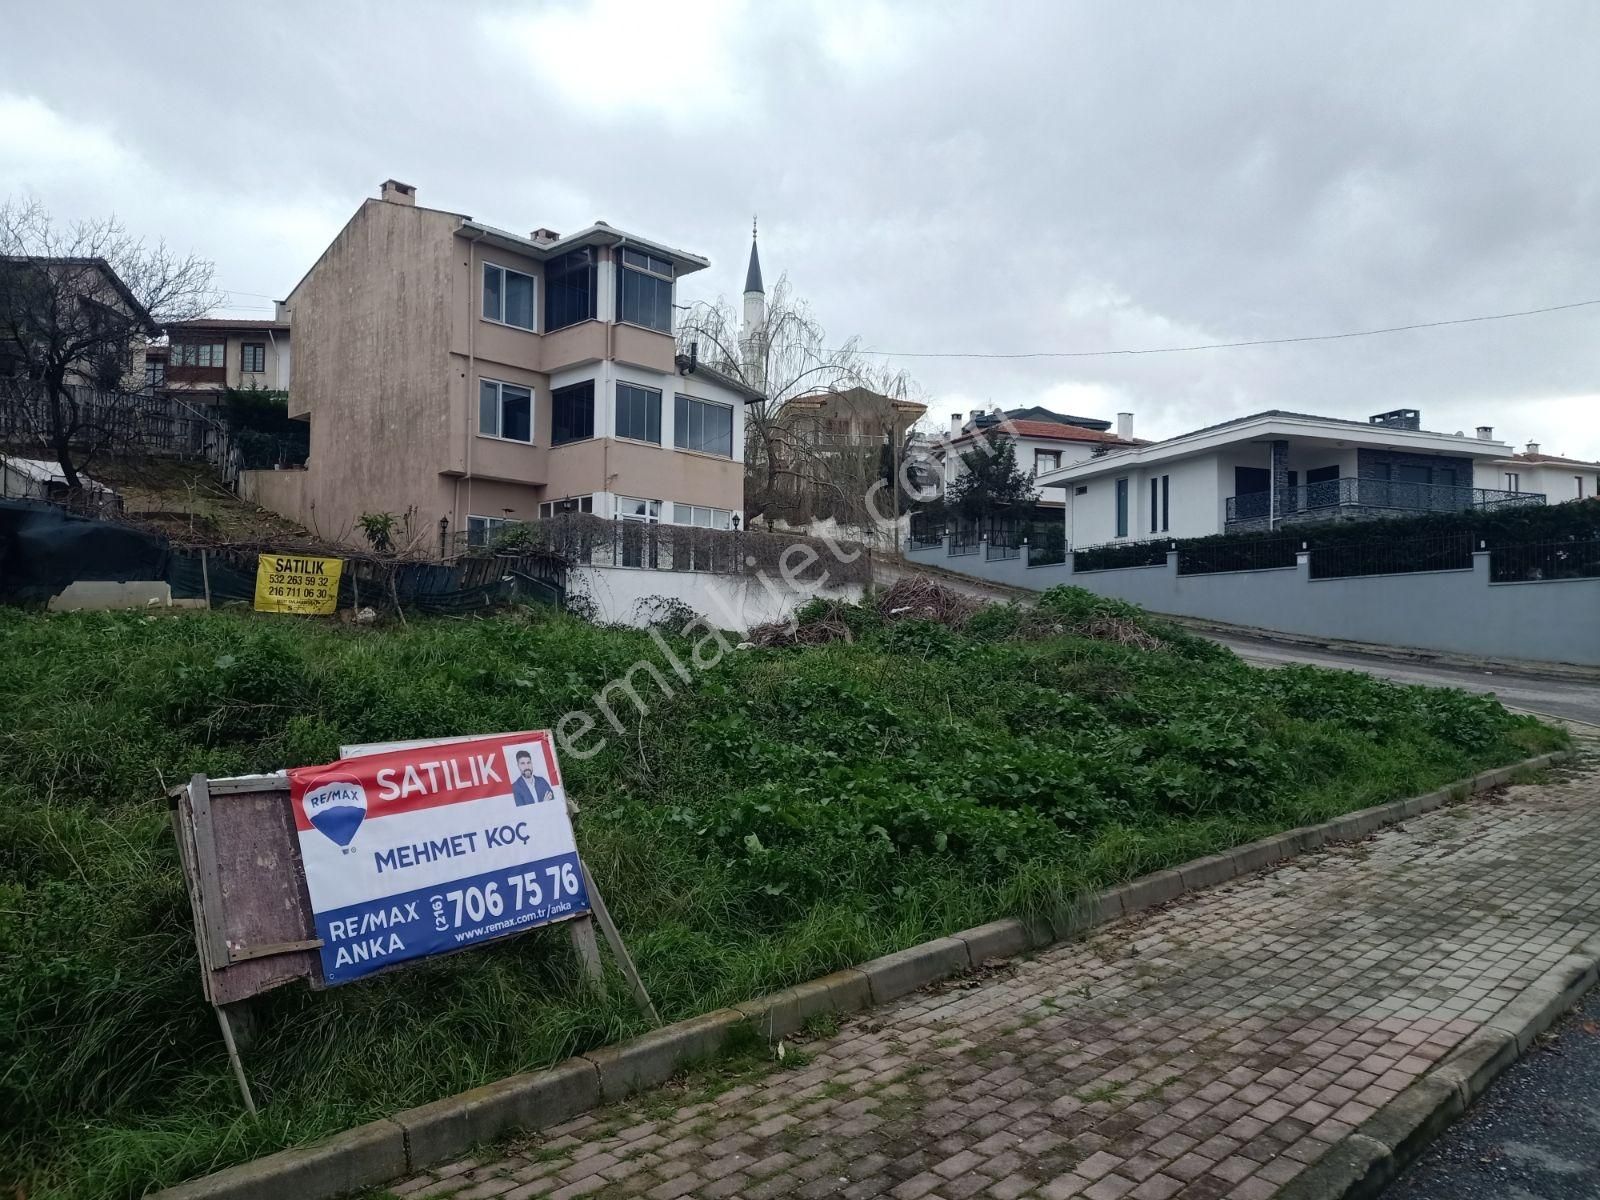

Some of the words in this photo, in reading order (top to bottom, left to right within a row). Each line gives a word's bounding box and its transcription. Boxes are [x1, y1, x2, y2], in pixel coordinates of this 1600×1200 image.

[269, 574, 285, 584] 532
[287, 576, 302, 585] 263
[305, 577, 315, 586] 59
[318, 578, 329, 587] 32
[275, 558, 324, 575] SATILIK
[268, 586, 284, 596] 216
[286, 587, 301, 597] 711
[303, 588, 314, 598] 06
[316, 589, 327, 598] 30
[376, 753, 502, 801] SATILIK
[310, 790, 359, 808] RE/MAX
[374, 831, 477, 873] MEHMET
[485, 822, 530, 849] KOÇ
[430, 895, 450, 932] (216)
[446, 881, 504, 928] 706
[507, 871, 543, 911] 75
[545, 862, 579, 899] 76
[328, 901, 420, 942] RE/MAX
[335, 933, 406, 969] ANKA
